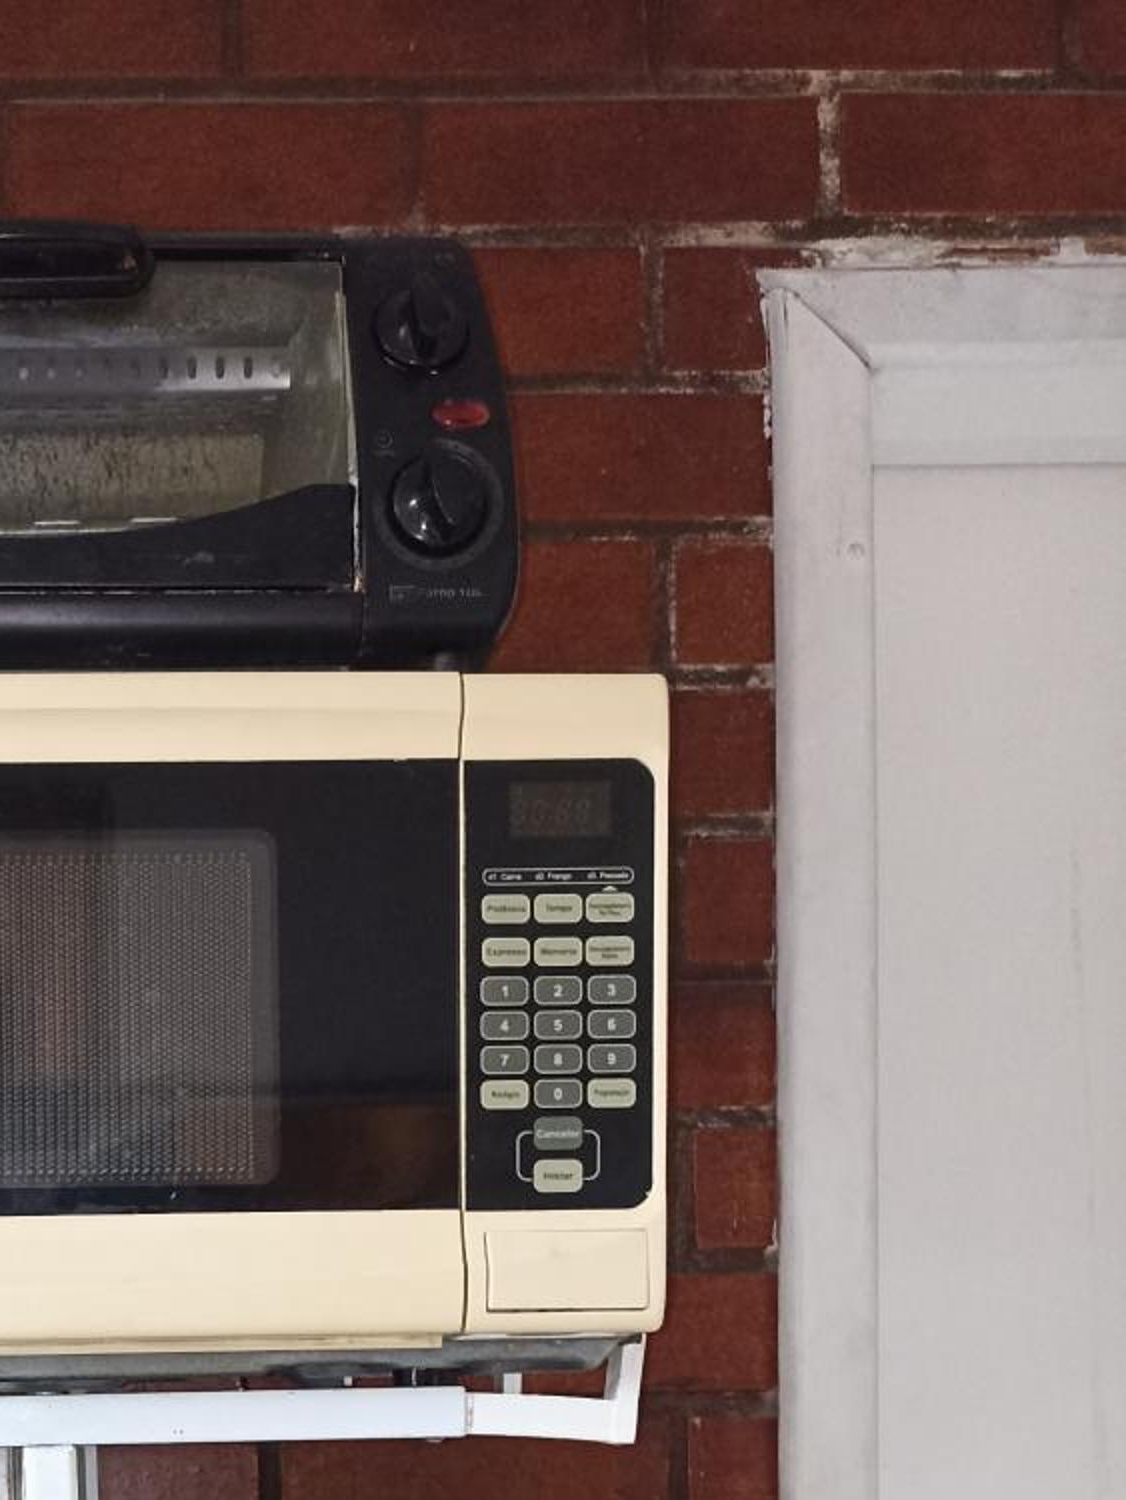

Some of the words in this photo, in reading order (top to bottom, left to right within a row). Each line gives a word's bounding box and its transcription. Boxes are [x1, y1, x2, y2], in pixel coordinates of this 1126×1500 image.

[501, 984, 510, 997] 1
[553, 984, 563, 997] 2
[607, 983, 617, 996] 3
[500, 1019, 510, 1031] 4
[553, 1019, 563, 1032] 5
[607, 1018, 617, 1031] 6
[500, 1053, 510, 1066] 7
[553, 1053, 563, 1066] 8
[607, 1052, 617, 1066] 9
[553, 1087, 563, 1101] 0
